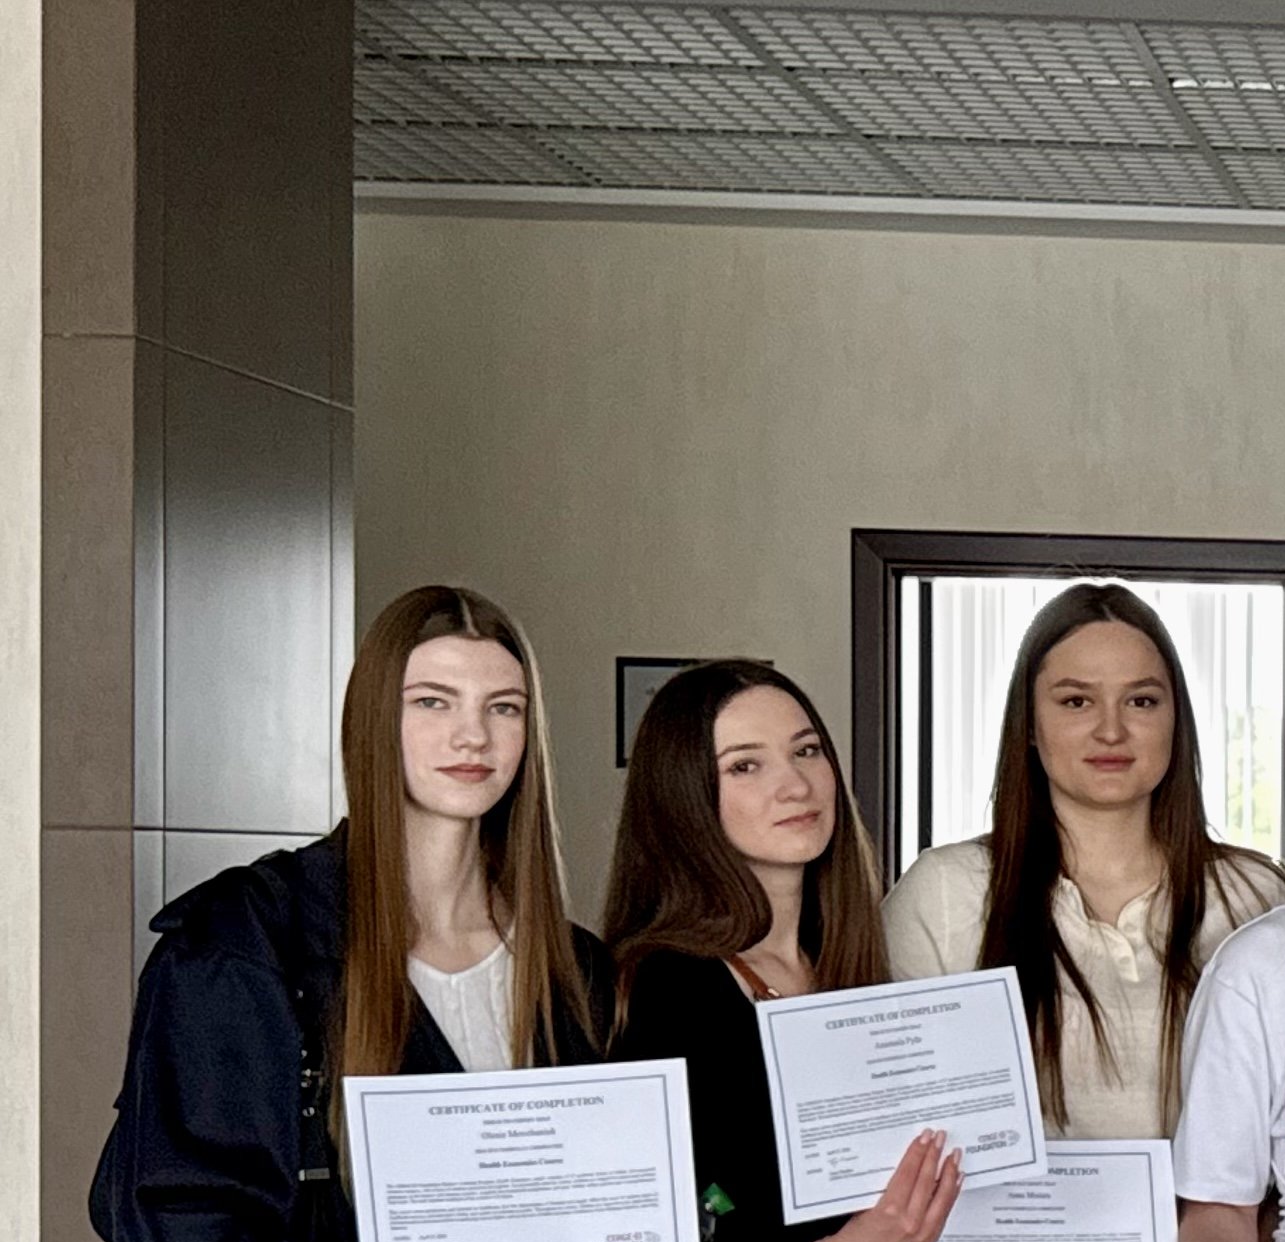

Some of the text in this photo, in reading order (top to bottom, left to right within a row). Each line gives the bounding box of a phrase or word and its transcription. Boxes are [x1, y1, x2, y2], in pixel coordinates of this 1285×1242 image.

[825, 1013, 885, 1030] CERTIFICATE
[886, 1011, 899, 1020] OF
[900, 1001, 961, 1018] COMPLETION
[429, 1096, 604, 1115] CERTIFICATE OF COMPLETION
[965, 1139, 1007, 1155] FOUNDATION
